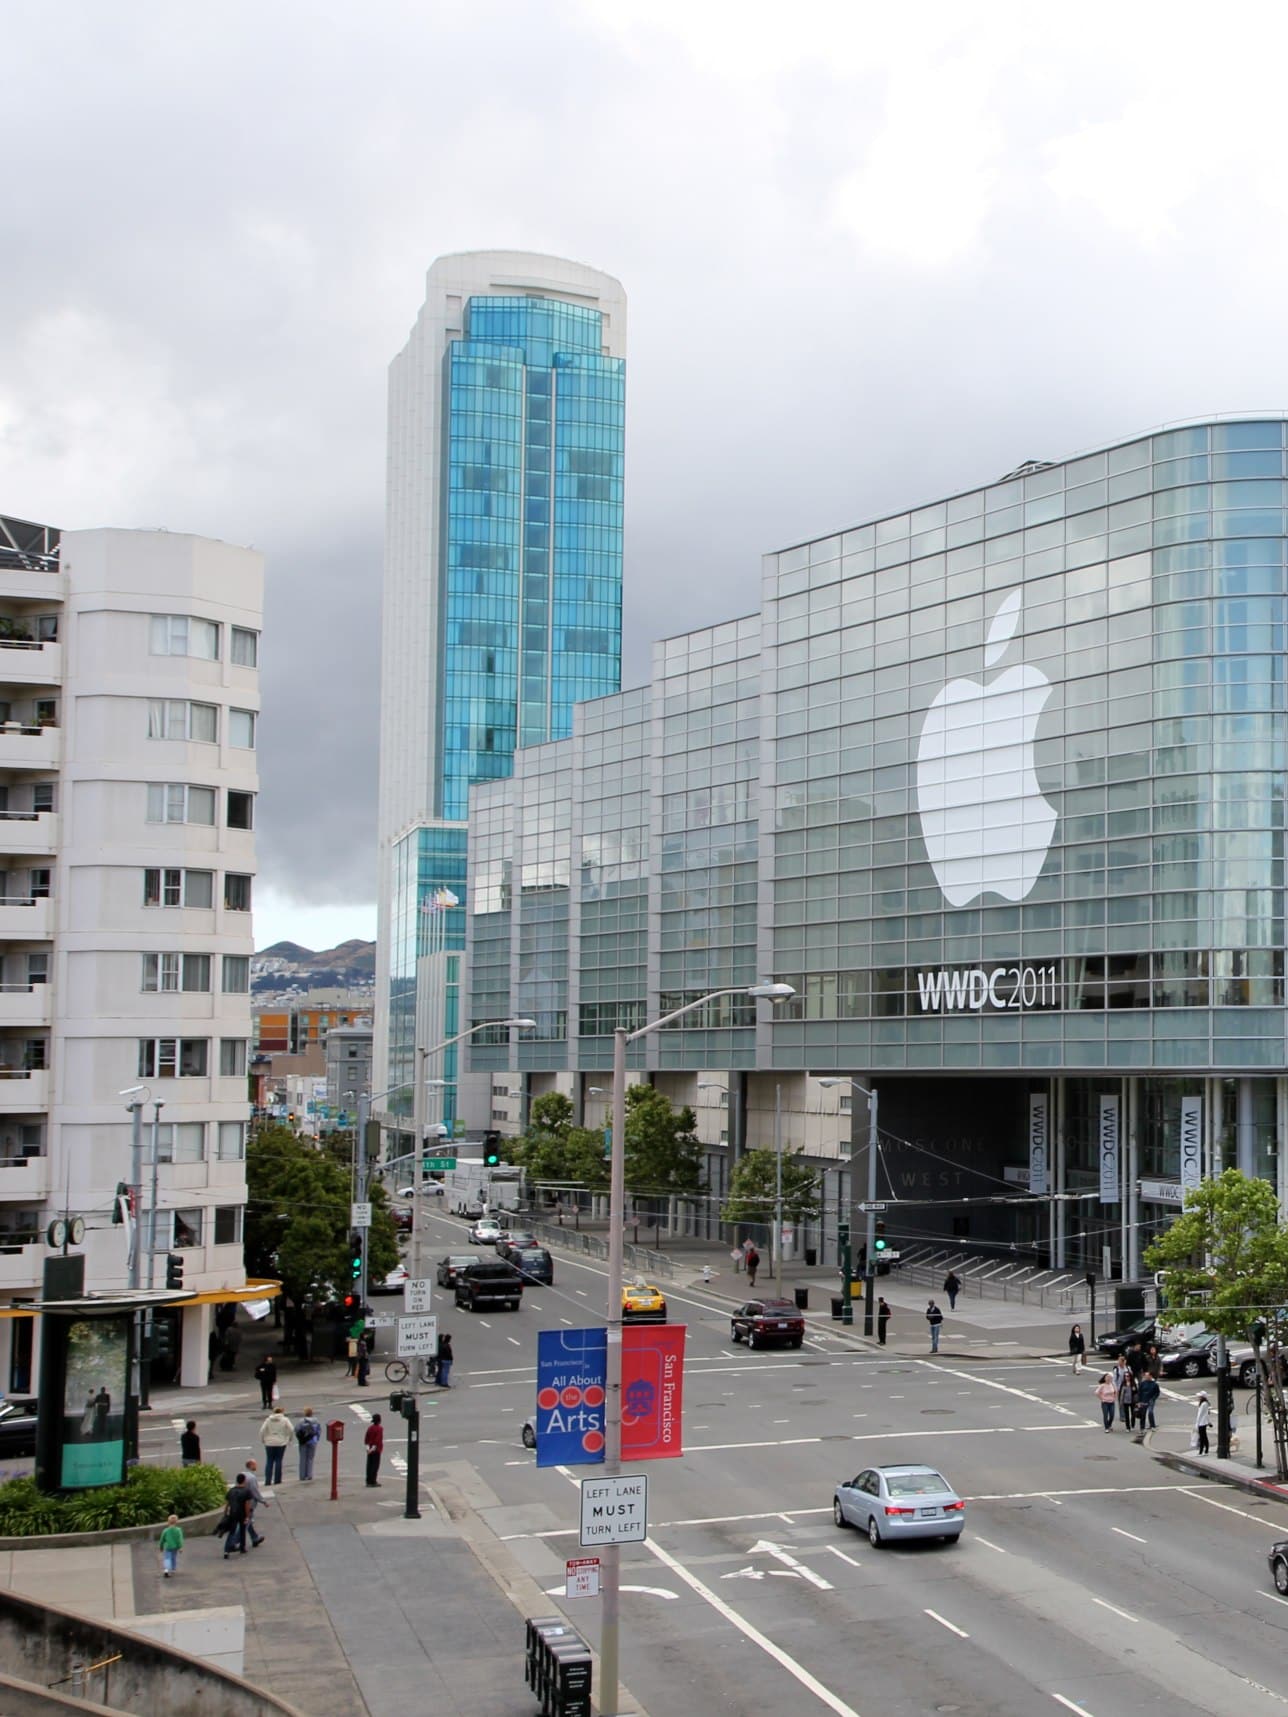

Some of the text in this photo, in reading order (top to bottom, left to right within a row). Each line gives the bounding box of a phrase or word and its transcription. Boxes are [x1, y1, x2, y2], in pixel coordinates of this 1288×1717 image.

[917, 966, 1056, 1010] WWDC2011
[1032, 1104, 1044, 1183] WWDC2011
[1103, 1107, 1115, 1190] WWDC2011
[1184, 1110, 1198, 1187] WWDC20
[902, 1171, 964, 1187] WEST
[411, 1281, 425, 1289] NO
[401, 1322, 417, 1330] LEFT
[405, 1332, 429, 1340] MUST
[552, 1375, 602, 1387] All About
[565, 1393, 578, 1401] the
[662, 1354, 677, 1443] San Francisco
[546, 1409, 600, 1434] Arts
[586, 1485, 641, 1499] LEFT LANE
[592, 1503, 635, 1517] MUST
[586, 1522, 641, 1536] TURN LEFT
